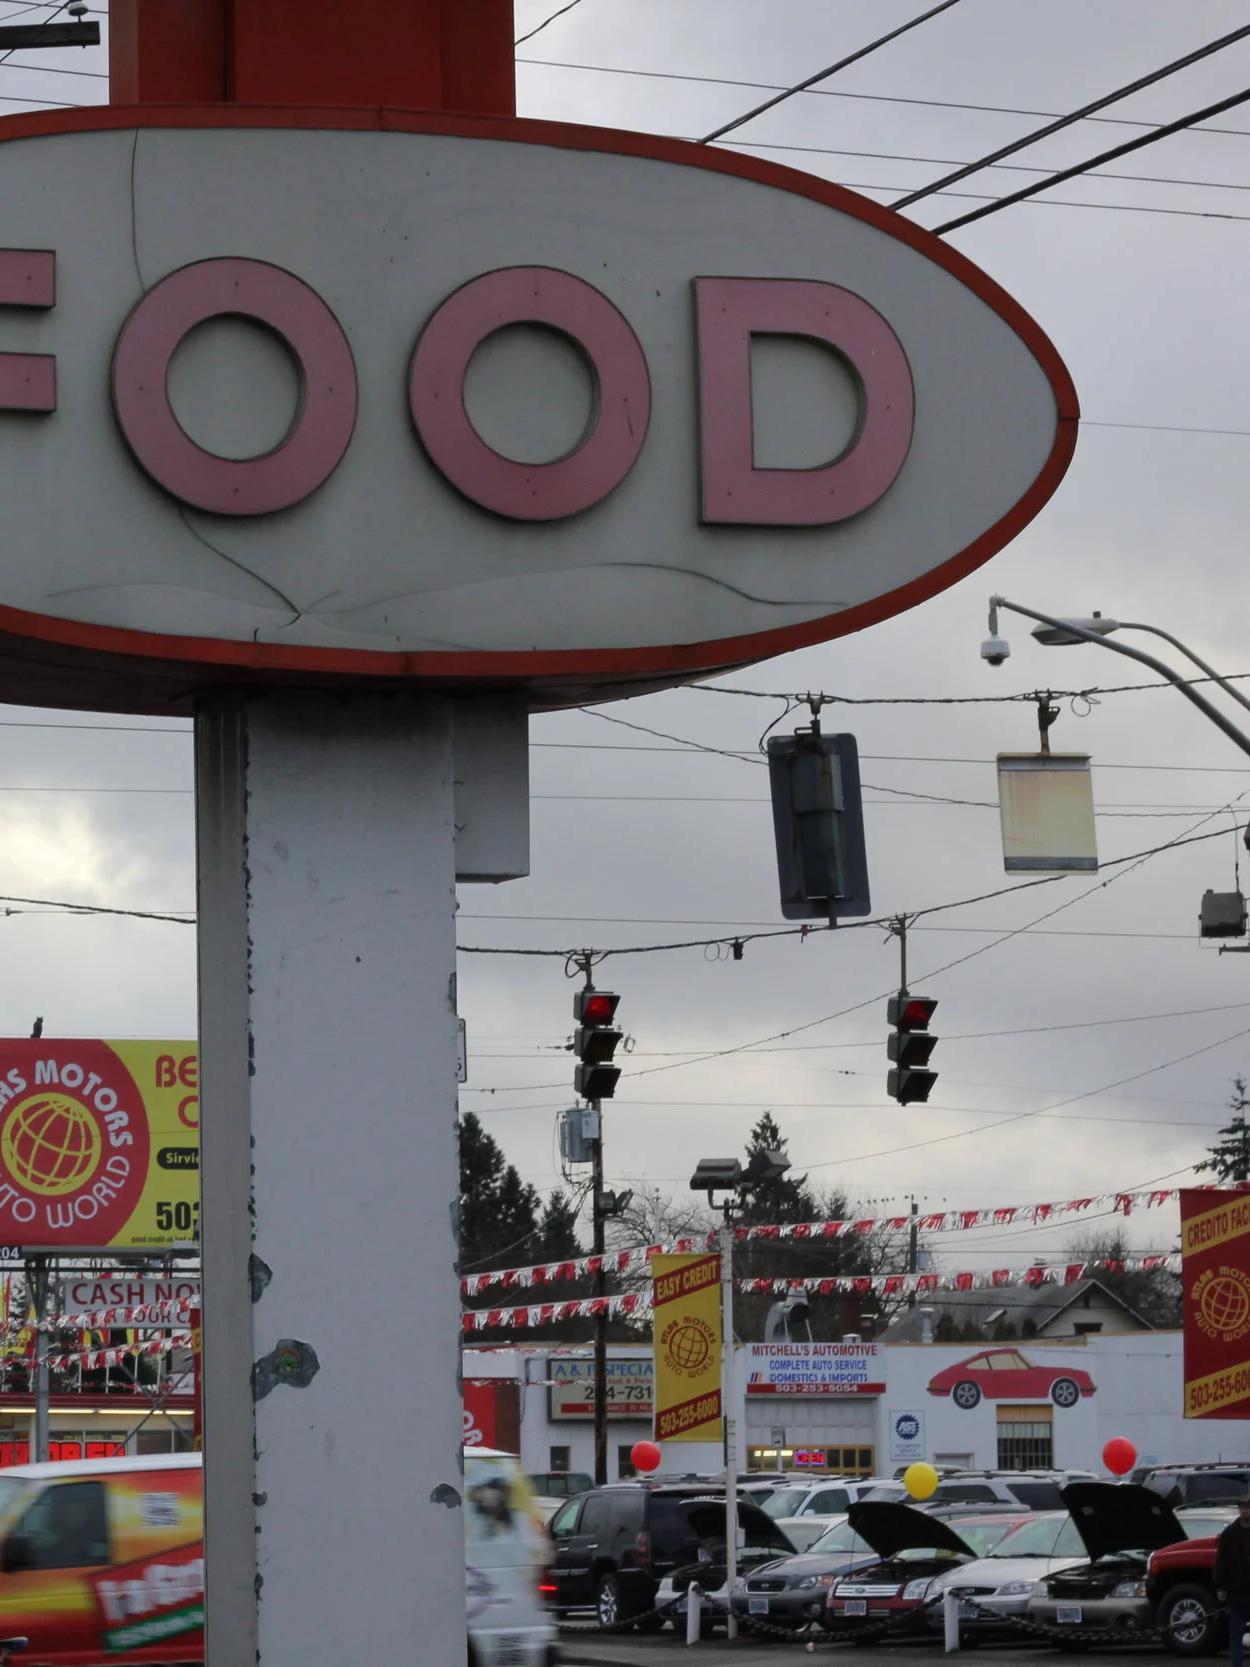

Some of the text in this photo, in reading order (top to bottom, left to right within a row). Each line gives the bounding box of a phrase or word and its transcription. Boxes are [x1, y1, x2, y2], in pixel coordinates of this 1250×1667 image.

[34, 1059, 134, 1148] MOTORS
[46, 1155, 130, 1229] WORLD
[1187, 1210, 1229, 1248] CREDITO
[656, 1260, 718, 1301] EASY CREDIT
[71, 1283, 200, 1305] CASH NO
[661, 1315, 717, 1346] ATLAS MOTORS
[1194, 1312, 1250, 1342] AUTO WORL
[752, 1345, 878, 1356] MITCHELL'S AUTOMOTIVE
[556, 1363, 566, 1376] A
[570, 1363, 582, 1376] &
[664, 1354, 716, 1379] AUTO WORLD
[769, 1359, 868, 1371] COMPLETE AUTO SERVICE
[770, 1373, 868, 1382] DOMESTICS & IMPORTS
[584, 1386, 653, 1400] 24-731
[660, 1396, 719, 1434] 503-255-6000
[796, 1452, 825, 1464] OPEN
